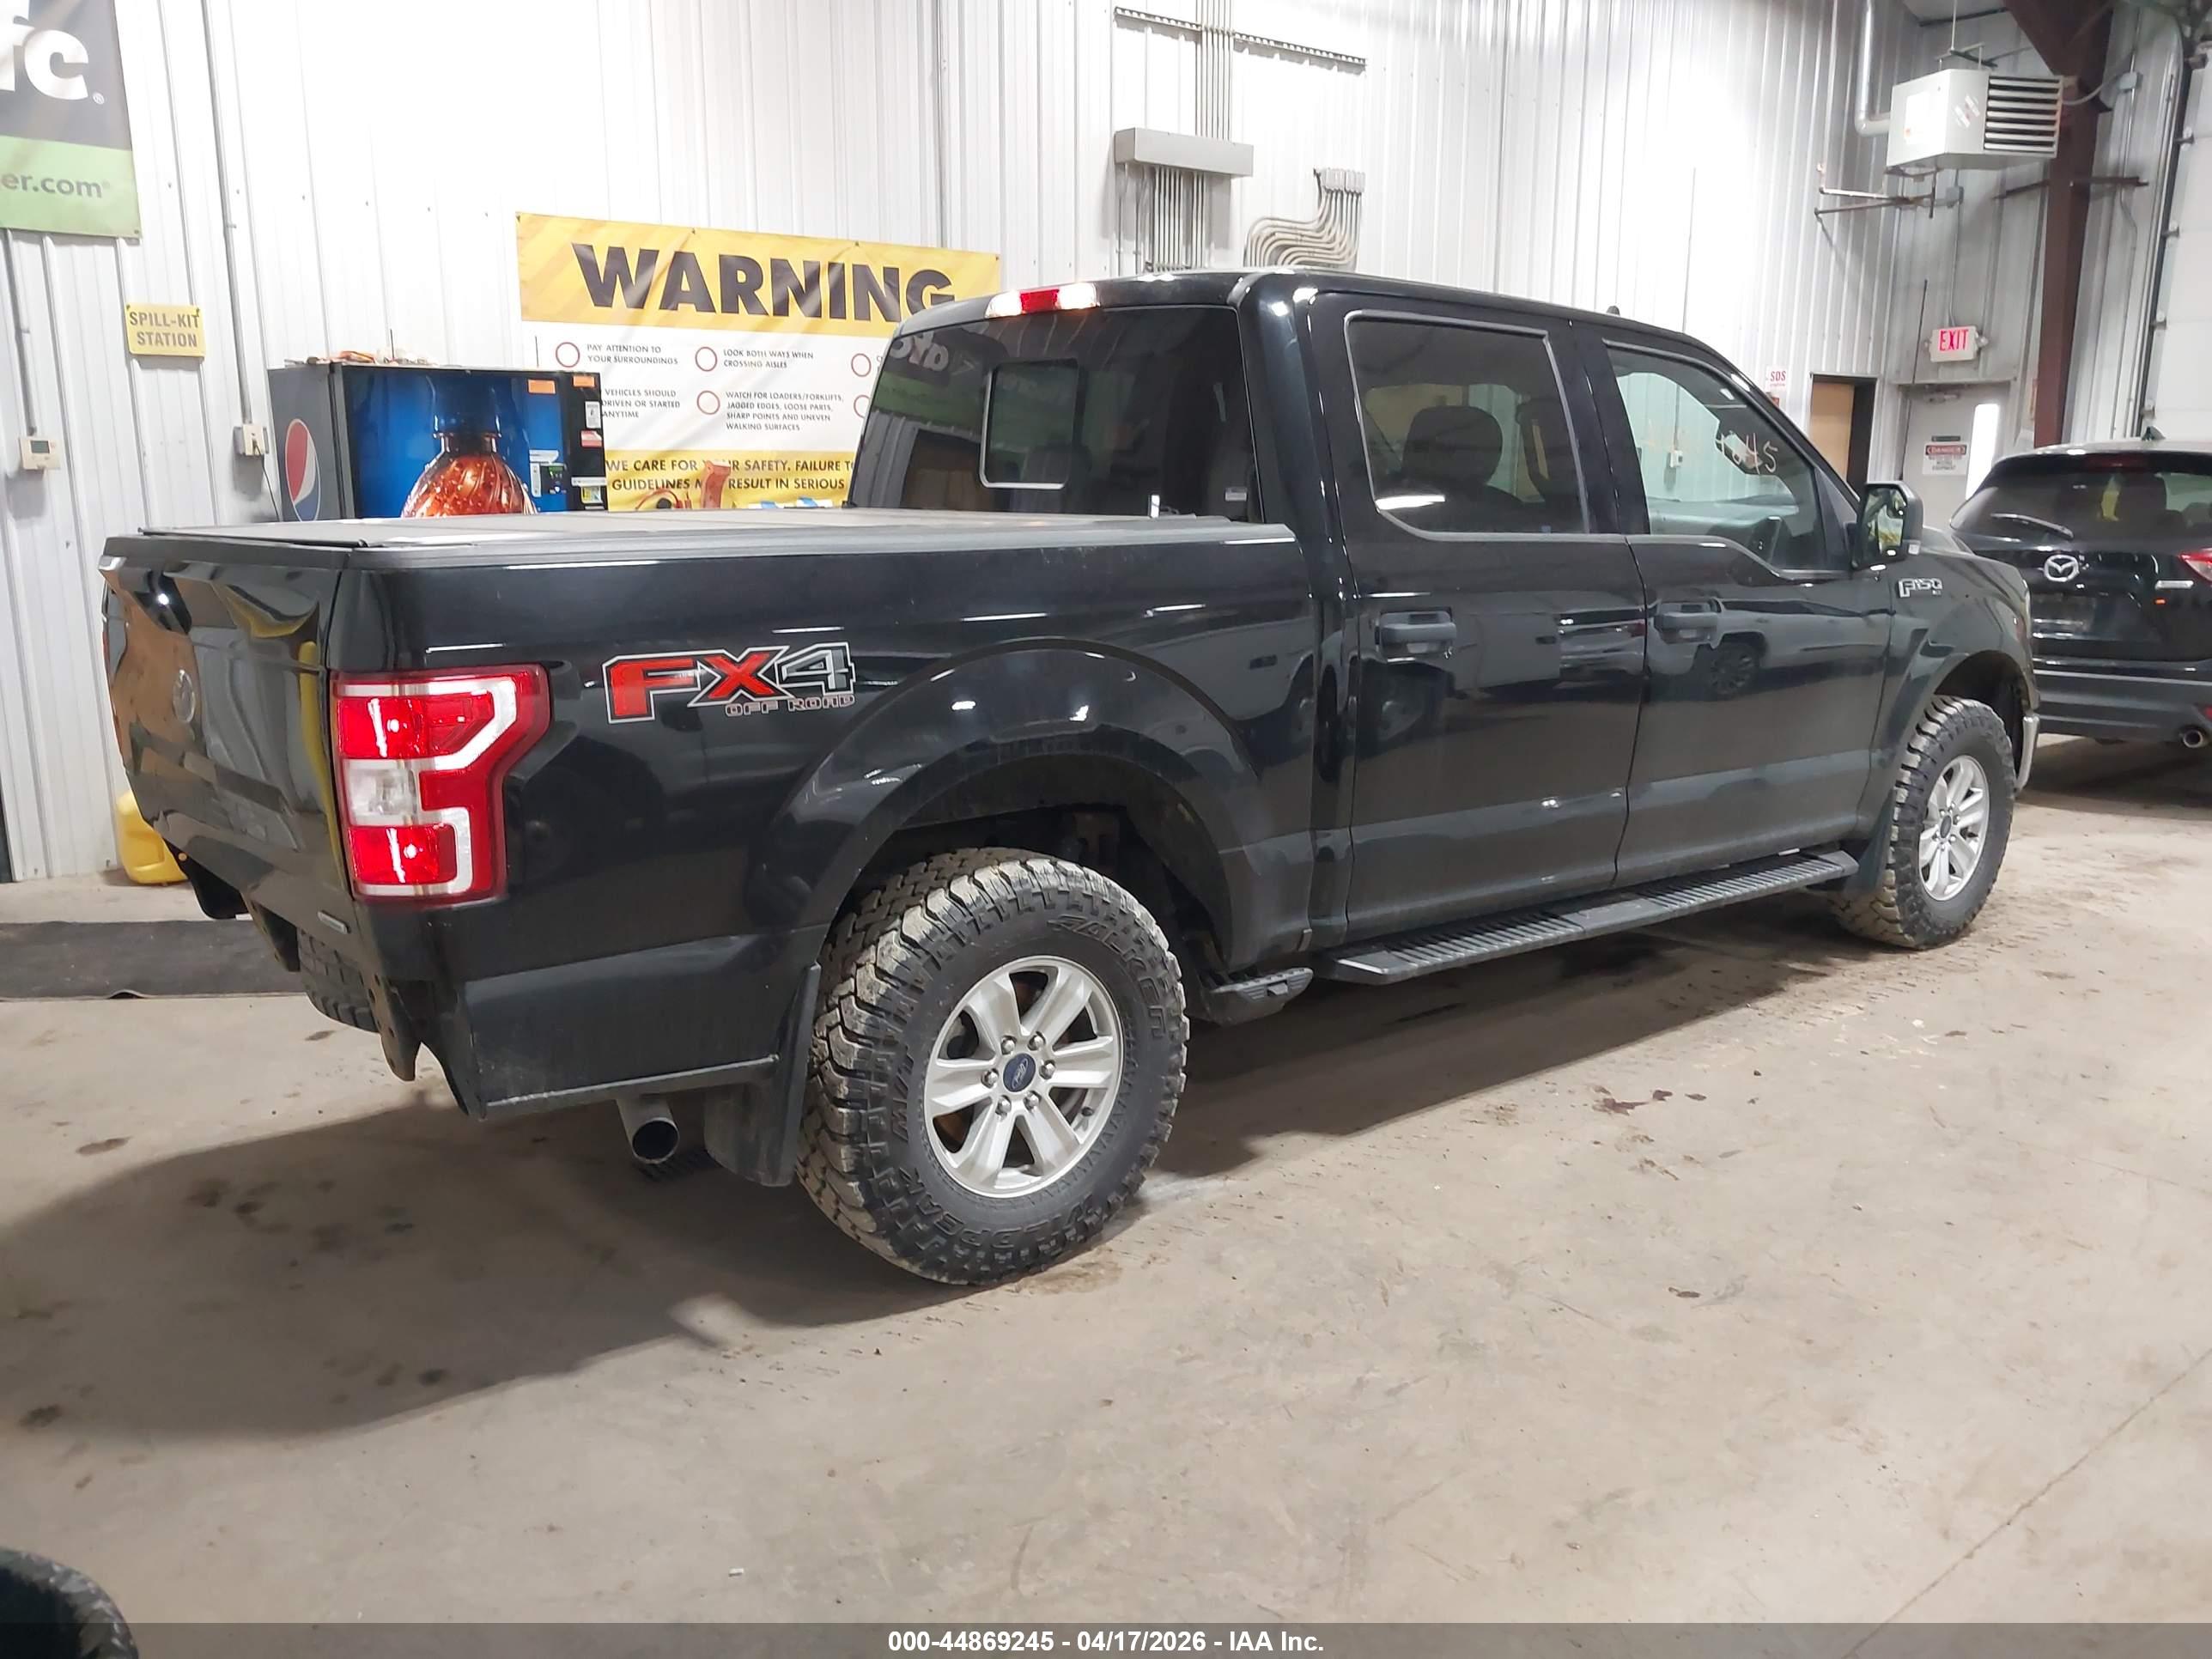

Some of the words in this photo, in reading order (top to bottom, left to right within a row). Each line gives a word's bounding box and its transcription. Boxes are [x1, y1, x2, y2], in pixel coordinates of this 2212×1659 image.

[571, 241, 956, 323] WARNING
[130, 311, 199, 328] SPILL-KIT
[137, 331, 198, 347] STATION
[1939, 329, 1969, 351] EXIT
[606, 345, 648, 354] ATTENTION
[651, 345, 661, 354] TO
[723, 349, 744, 357] LOOK
[746, 349, 767, 358] BOTH
[769, 350, 790, 359] WAYS
[791, 350, 814, 359] WHEN
[587, 355, 611, 364] YOUR
[613, 356, 678, 365] SURROUNDINGS
[723, 360, 763, 368] CROSSING
[765, 361, 787, 369] AISLES
[1770, 370, 1787, 382] SDS
[605, 388, 641, 397] VEHICLES
[644, 389, 677, 398] SHOULD
[769, 392, 844, 403] LOADERS/FORKLIFTS,
[635, 399, 646, 408] OR
[649, 400, 681, 409] STARTED
[727, 402, 755, 410] JAGGED
[784, 403, 807, 411] LOOSE
[764, 423, 800, 432] SURFACES
[605, 459, 629, 471] WE
[633, 459, 666, 471] CARE
[671, 459, 698, 471] FOR
[744, 460, 791, 471] SAFETY.
[795, 460, 841, 471] FAILURE
[611, 478, 691, 491] GUIDELINES
[729, 478, 771, 489] RESULT
[775, 478, 789, 489] IN
[794, 479, 845, 490] SERIOUS
[602, 641, 856, 724] FX4
[725, 700, 779, 717] OFF
[788, 694, 855, 712] ROAD
